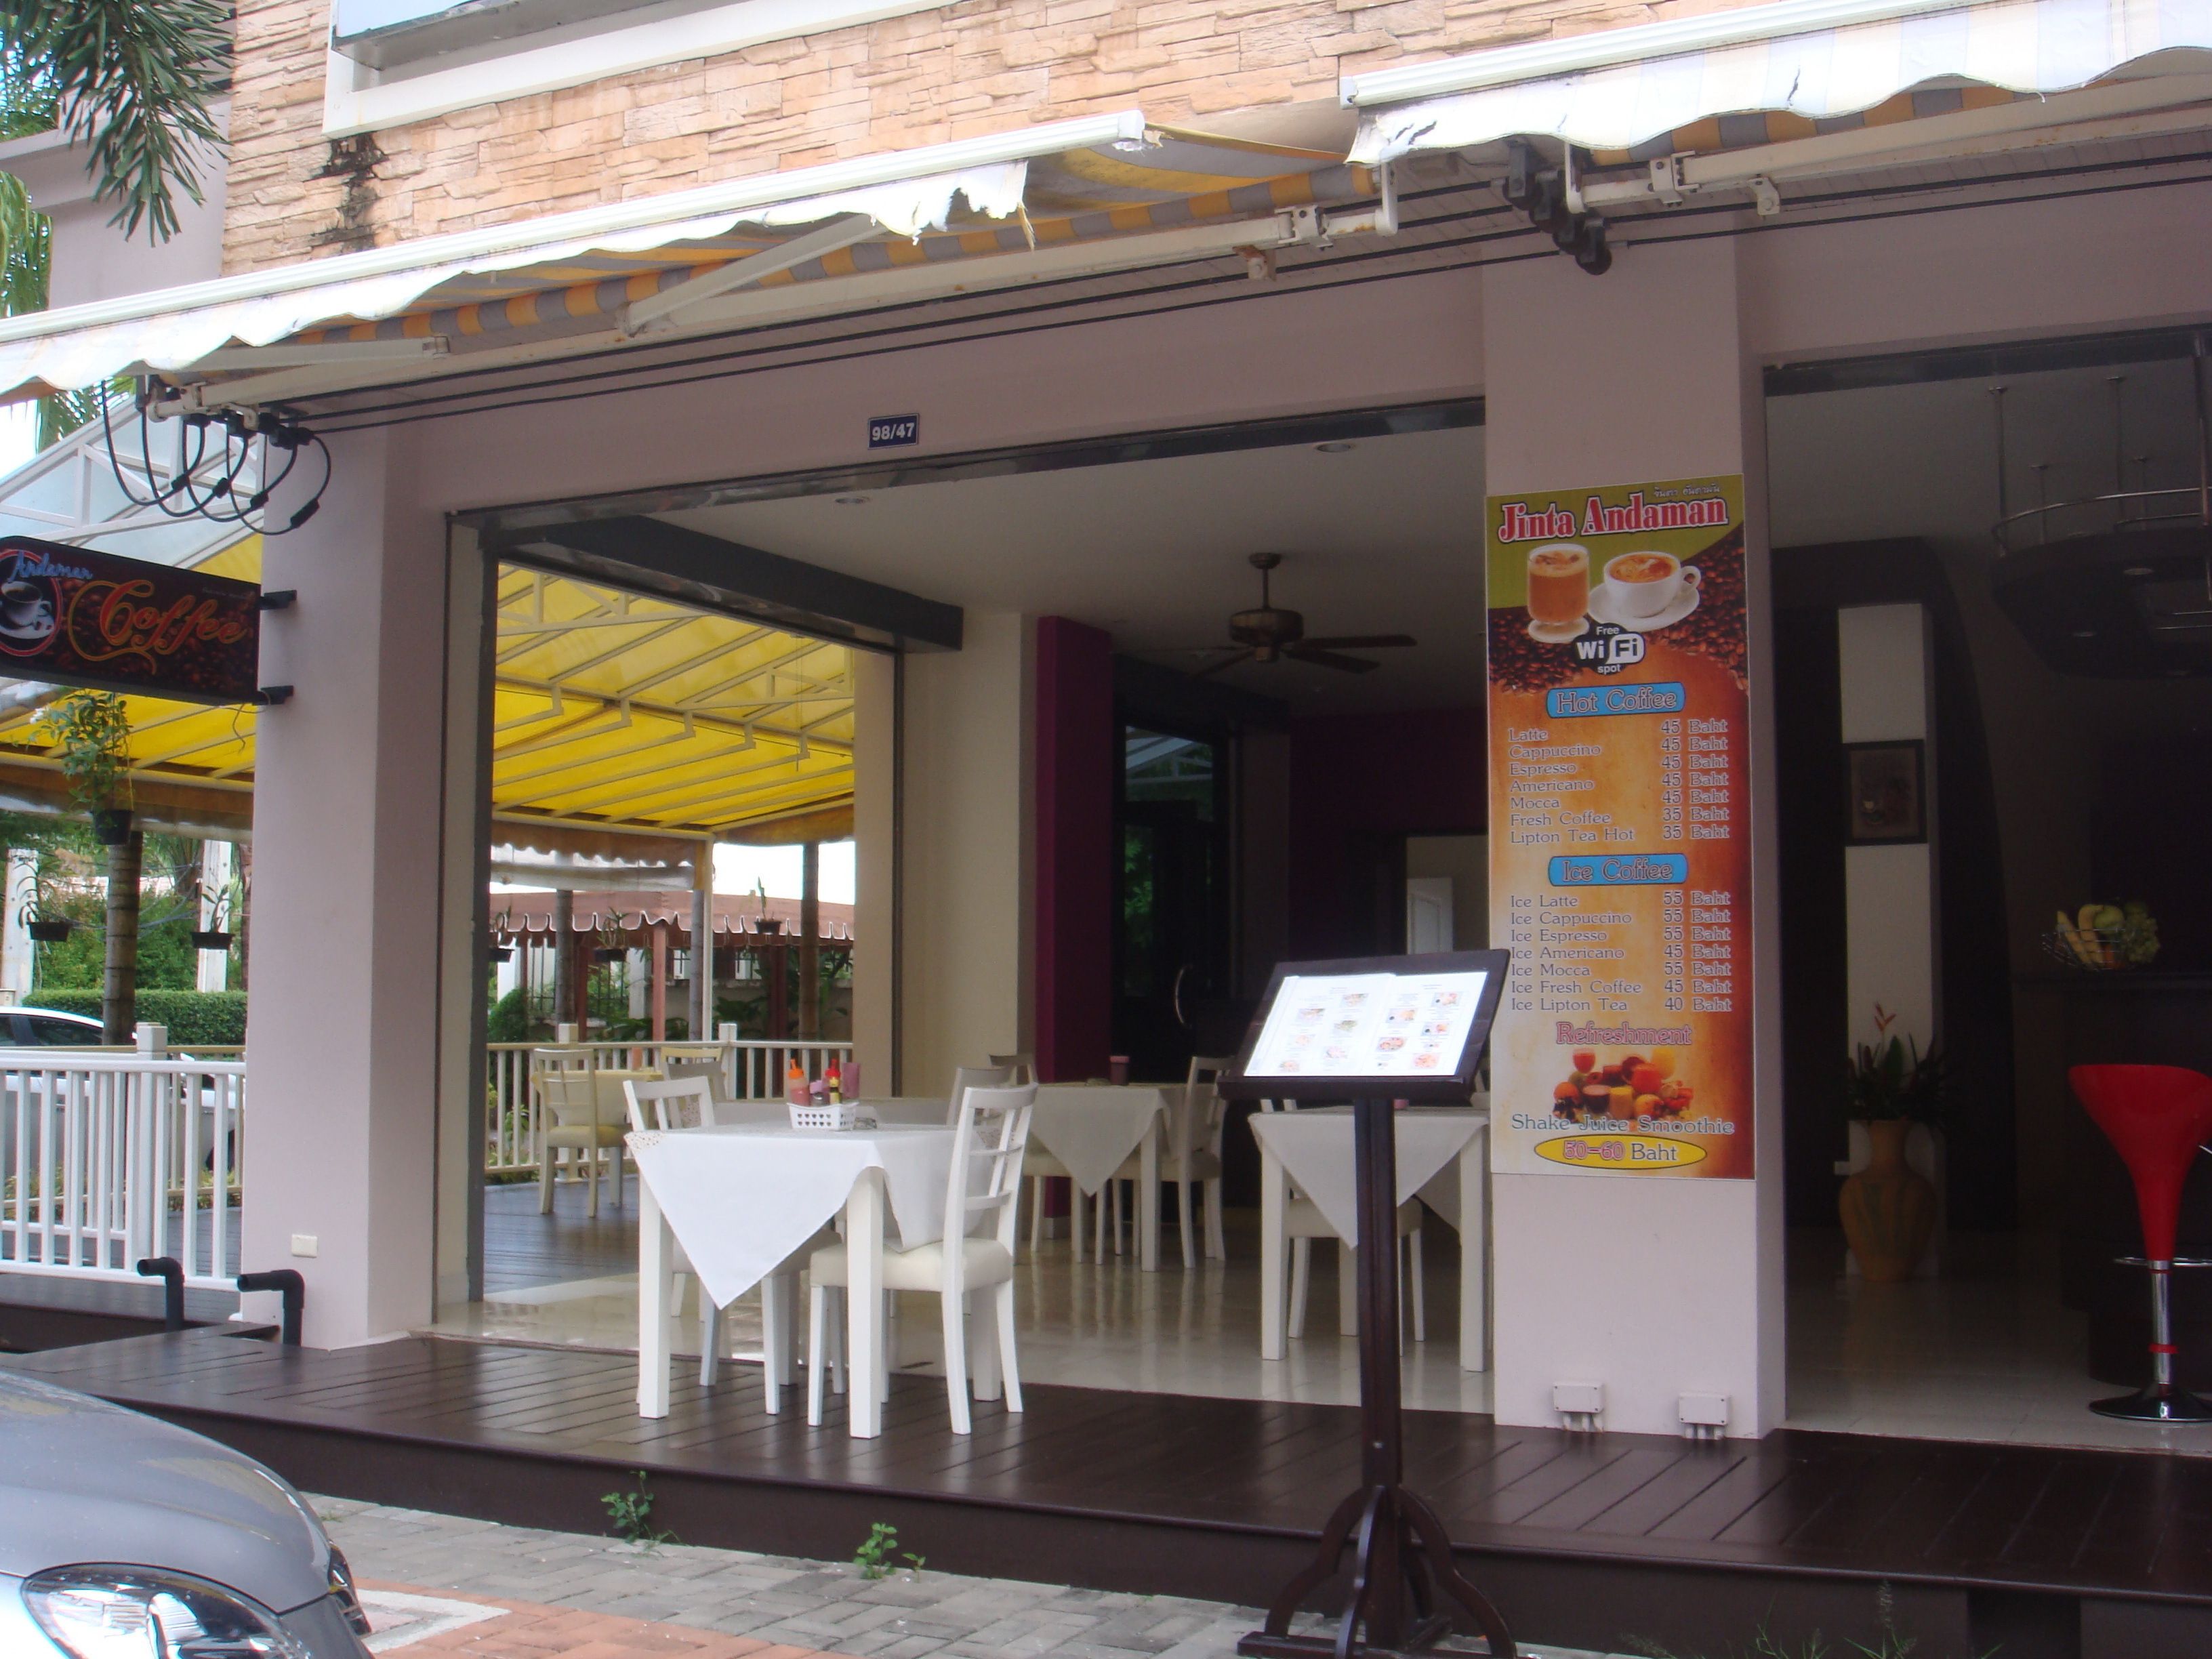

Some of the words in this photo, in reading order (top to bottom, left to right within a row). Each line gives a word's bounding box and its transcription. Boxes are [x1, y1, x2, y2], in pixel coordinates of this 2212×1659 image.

[872, 422, 915, 441] 98/47
[1498, 503, 1575, 542] Jinta
[1580, 494, 1728, 535] Andaman
[69, 579, 247, 674] Coffee
[1596, 626, 1620, 636] Free
[1597, 664, 1621, 675] spot
[1556, 691, 1598, 714] Hot
[1605, 687, 1677, 711] Coffee
[1509, 728, 1548, 742] Latte
[1661, 720, 1680, 734] 45
[1688, 719, 1727, 734] Baht
[1509, 745, 1601, 760] Cappuccino
[1661, 737, 1681, 752] 45
[1689, 736, 1728, 751] Baht
[1510, 763, 1576, 778] Espresso
[1662, 755, 1681, 769] 45
[1689, 754, 1728, 769] Baht
[1510, 780, 1594, 793] Americano
[1662, 773, 1681, 787] 45
[1689, 771, 1728, 787] Baht
[1511, 797, 1560, 810] Mocca
[1662, 790, 1681, 804] 45
[1690, 789, 1729, 804] Baht
[1511, 813, 1552, 827] Fresh
[1559, 812, 1611, 825] Coffee
[1663, 807, 1681, 821] 35
[1690, 806, 1729, 821] Baht
[1511, 831, 1559, 846] Lipton
[1568, 830, 1597, 842] Tea
[1605, 828, 1634, 841] Hot
[1663, 825, 1681, 840] 35
[1690, 824, 1729, 840] Baht
[1562, 860, 1593, 882] Ice
[1601, 858, 1673, 881] Coffee
[1511, 895, 1532, 908] Ice
[1540, 895, 1578, 908] Latte
[1664, 890, 1683, 905] 55
[1692, 891, 1732, 906] Baht
[1511, 912, 1532, 925] Ice
[1540, 912, 1632, 927] Cappuccino
[1664, 909, 1683, 923] 55
[1692, 909, 1732, 924] Baht
[1511, 930, 1532, 943] Ice
[1540, 929, 1607, 944] Espresso
[1664, 926, 1683, 941] 55
[1692, 927, 1732, 942] Baht
[1511, 947, 1533, 960] Ice
[1540, 947, 1625, 960] Americano
[1664, 945, 1683, 958] 45
[1692, 945, 1732, 960] Baht
[1511, 964, 1533, 977] Ice
[1540, 964, 1591, 977] Mocca
[1664, 962, 1683, 976] 55
[1692, 962, 1732, 977] Baht
[1511, 981, 1533, 994] Ice
[1540, 981, 1582, 994] Fresh
[1590, 980, 1641, 994] Coffee
[1664, 979, 1684, 993] 45
[1692, 980, 1732, 994] Baht
[1511, 998, 1533, 1011] Ice
[1540, 998, 1591, 1013] Lipton
[1598, 998, 1627, 1011] Tea
[1664, 998, 1684, 1011] 40
[1692, 998, 1732, 1012] Baht
[1556, 1022, 1692, 1045] Refreshment
[1511, 1114, 1570, 1130] Shake
[1579, 1115, 1629, 1131] Juice
[1639, 1115, 1734, 1134] Smoothie
[1563, 1141, 1625, 1160] 50-60
[1631, 1143, 1677, 1161] Baht
